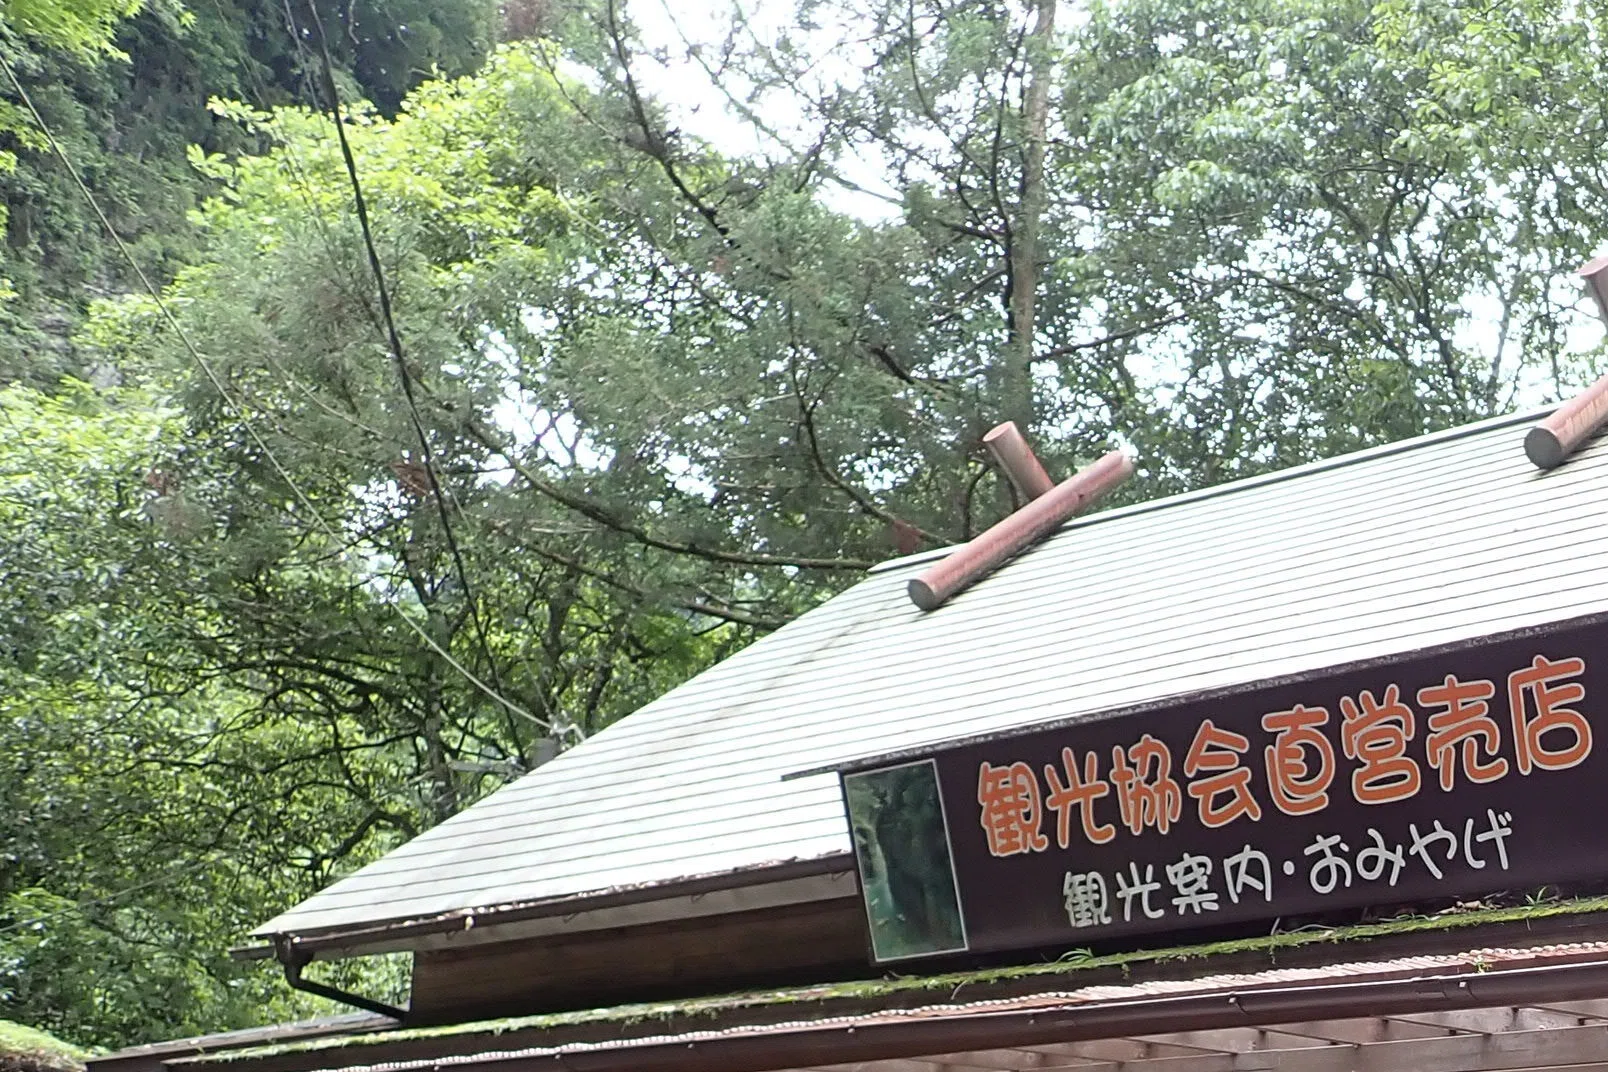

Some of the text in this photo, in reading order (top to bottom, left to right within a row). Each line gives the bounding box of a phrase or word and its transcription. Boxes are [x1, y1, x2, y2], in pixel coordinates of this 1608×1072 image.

[976, 654, 1595, 857] 観光協会直営売店
[1062, 807, 1513, 929] 観光案内・おみやげ
